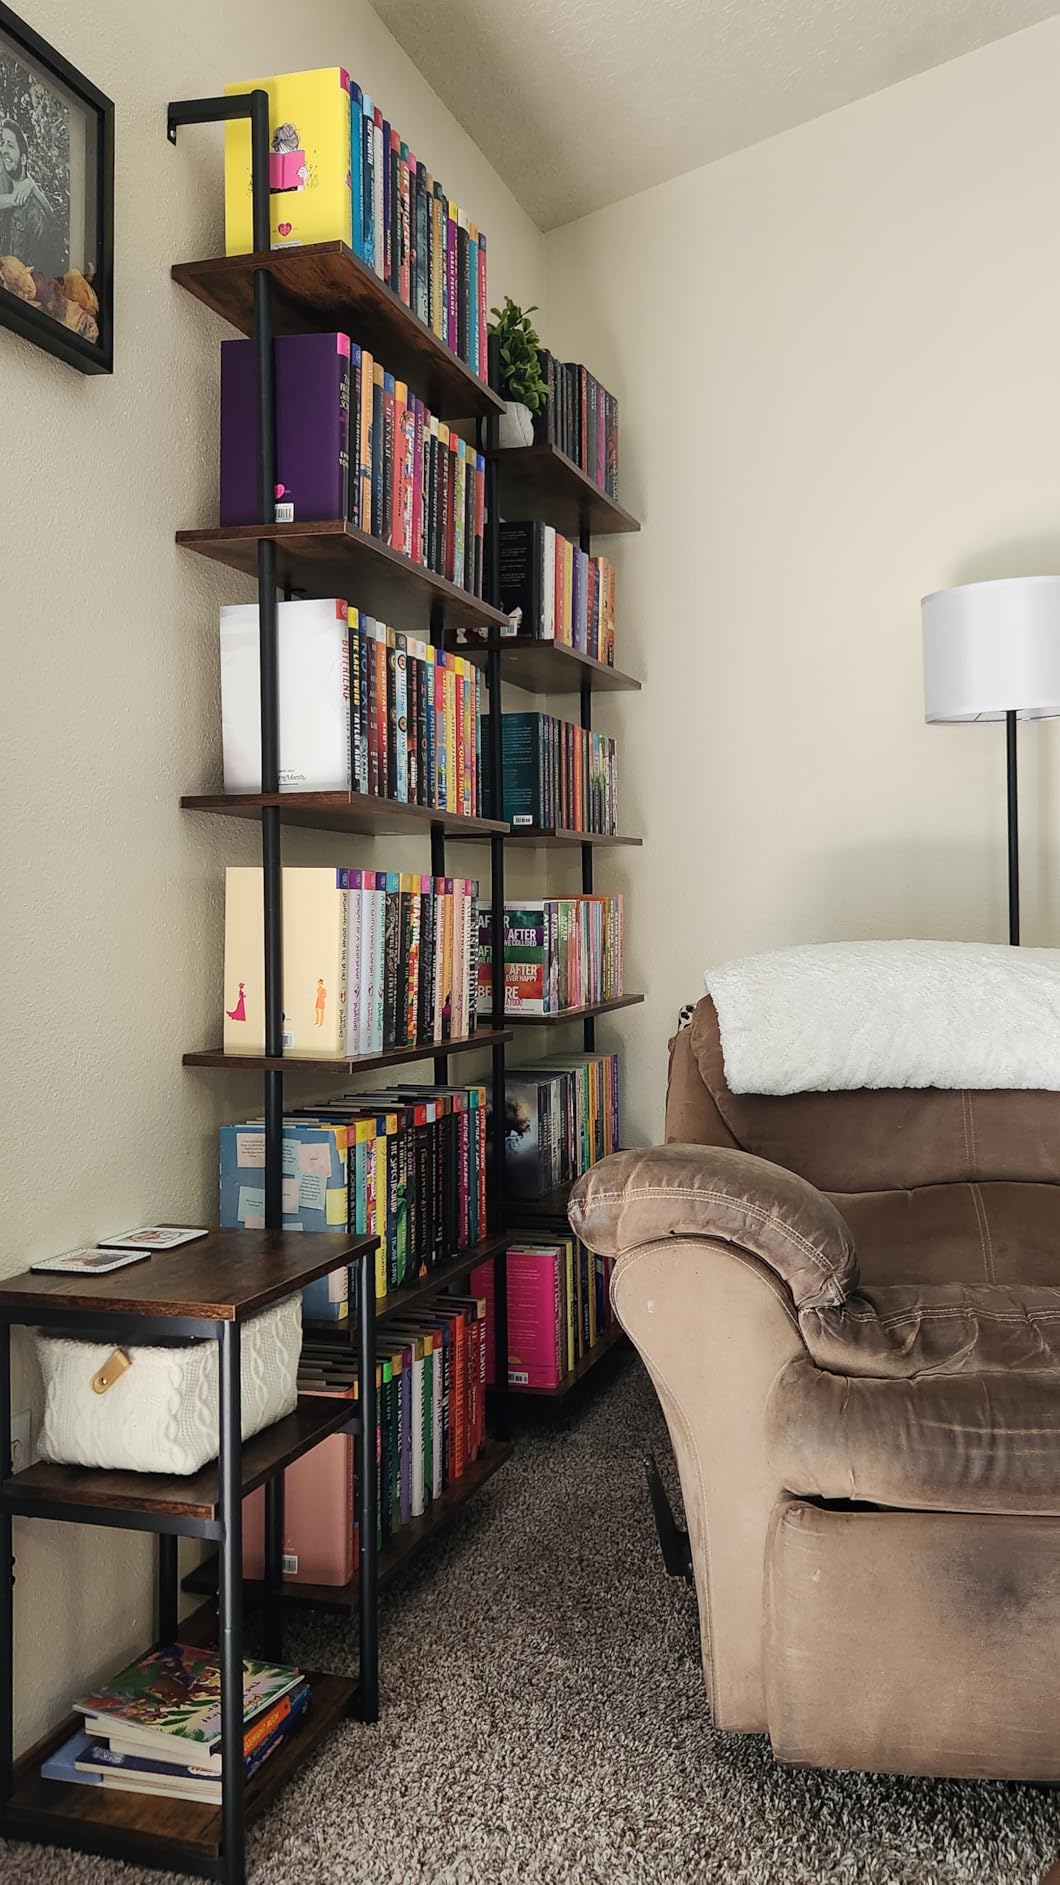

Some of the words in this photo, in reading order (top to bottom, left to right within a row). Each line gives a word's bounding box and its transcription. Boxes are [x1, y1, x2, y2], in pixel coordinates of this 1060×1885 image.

[342, 640, 350, 698] BOYFRIEND
[361, 642, 367, 673] NO
[469, 921, 477, 965] NINTH
[508, 929, 537, 941] AFTER
[506, 975, 520, 983] EVER
[520, 975, 538, 983] HAPPY
[509, 964, 538, 976] AFTER
[469, 970, 477, 1012] HOUSE
